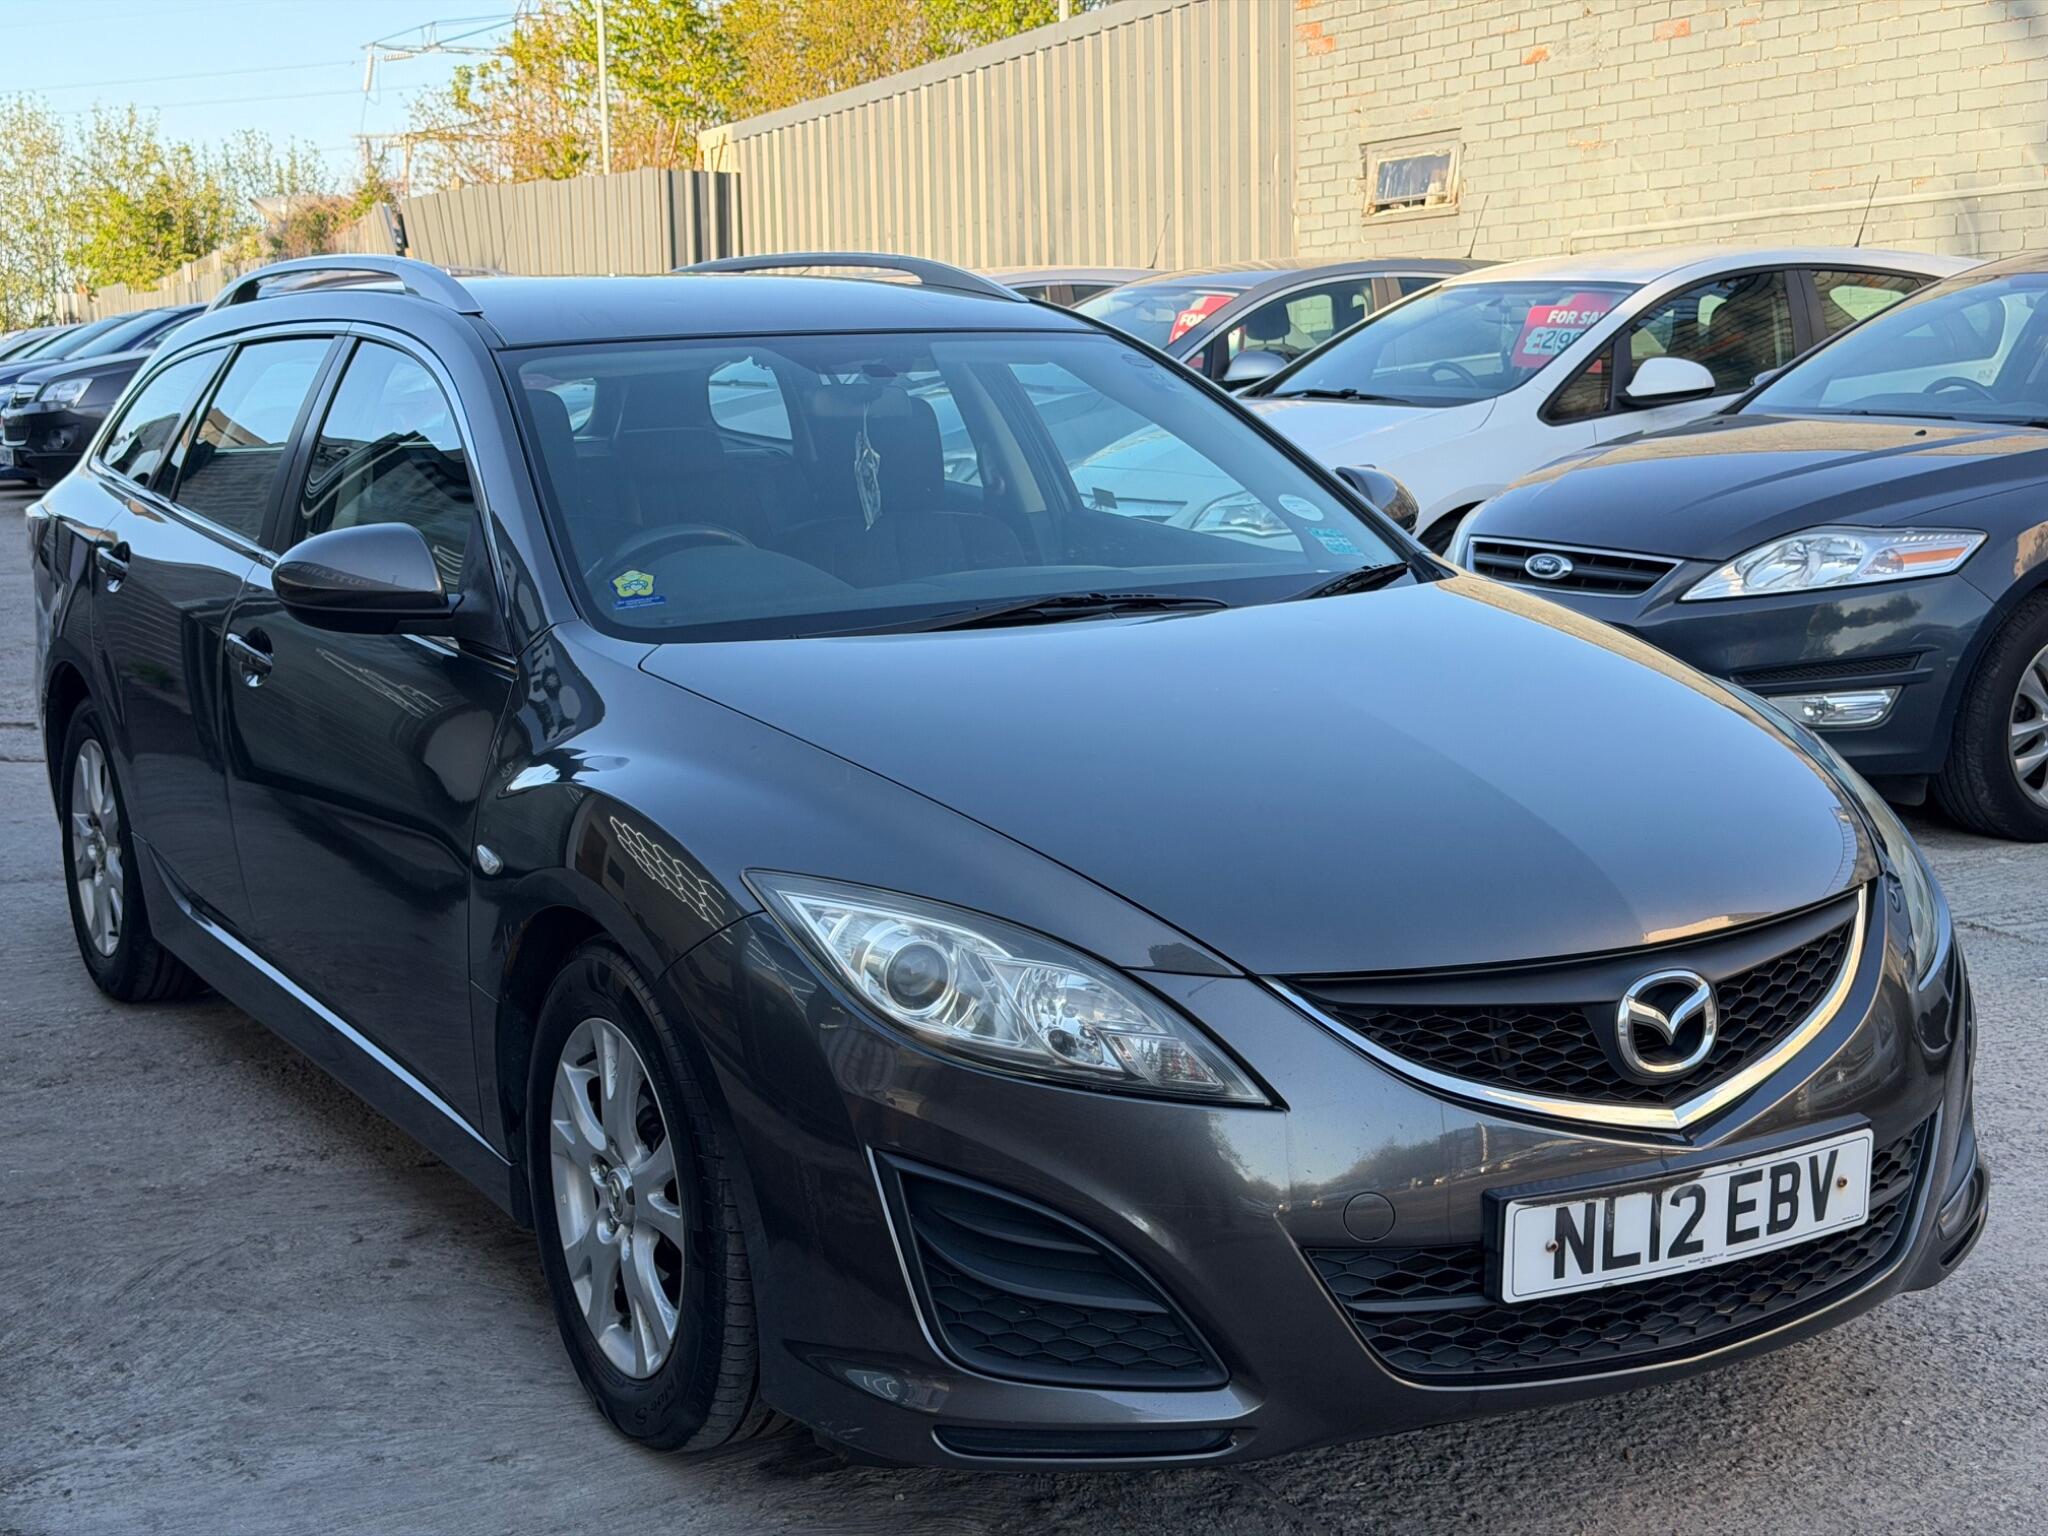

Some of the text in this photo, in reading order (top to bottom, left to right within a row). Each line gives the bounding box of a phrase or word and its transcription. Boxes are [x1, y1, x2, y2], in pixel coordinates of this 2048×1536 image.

[1547, 310, 1607, 325] FOR SA
[1553, 1149, 1839, 1280] NL12 EBV
